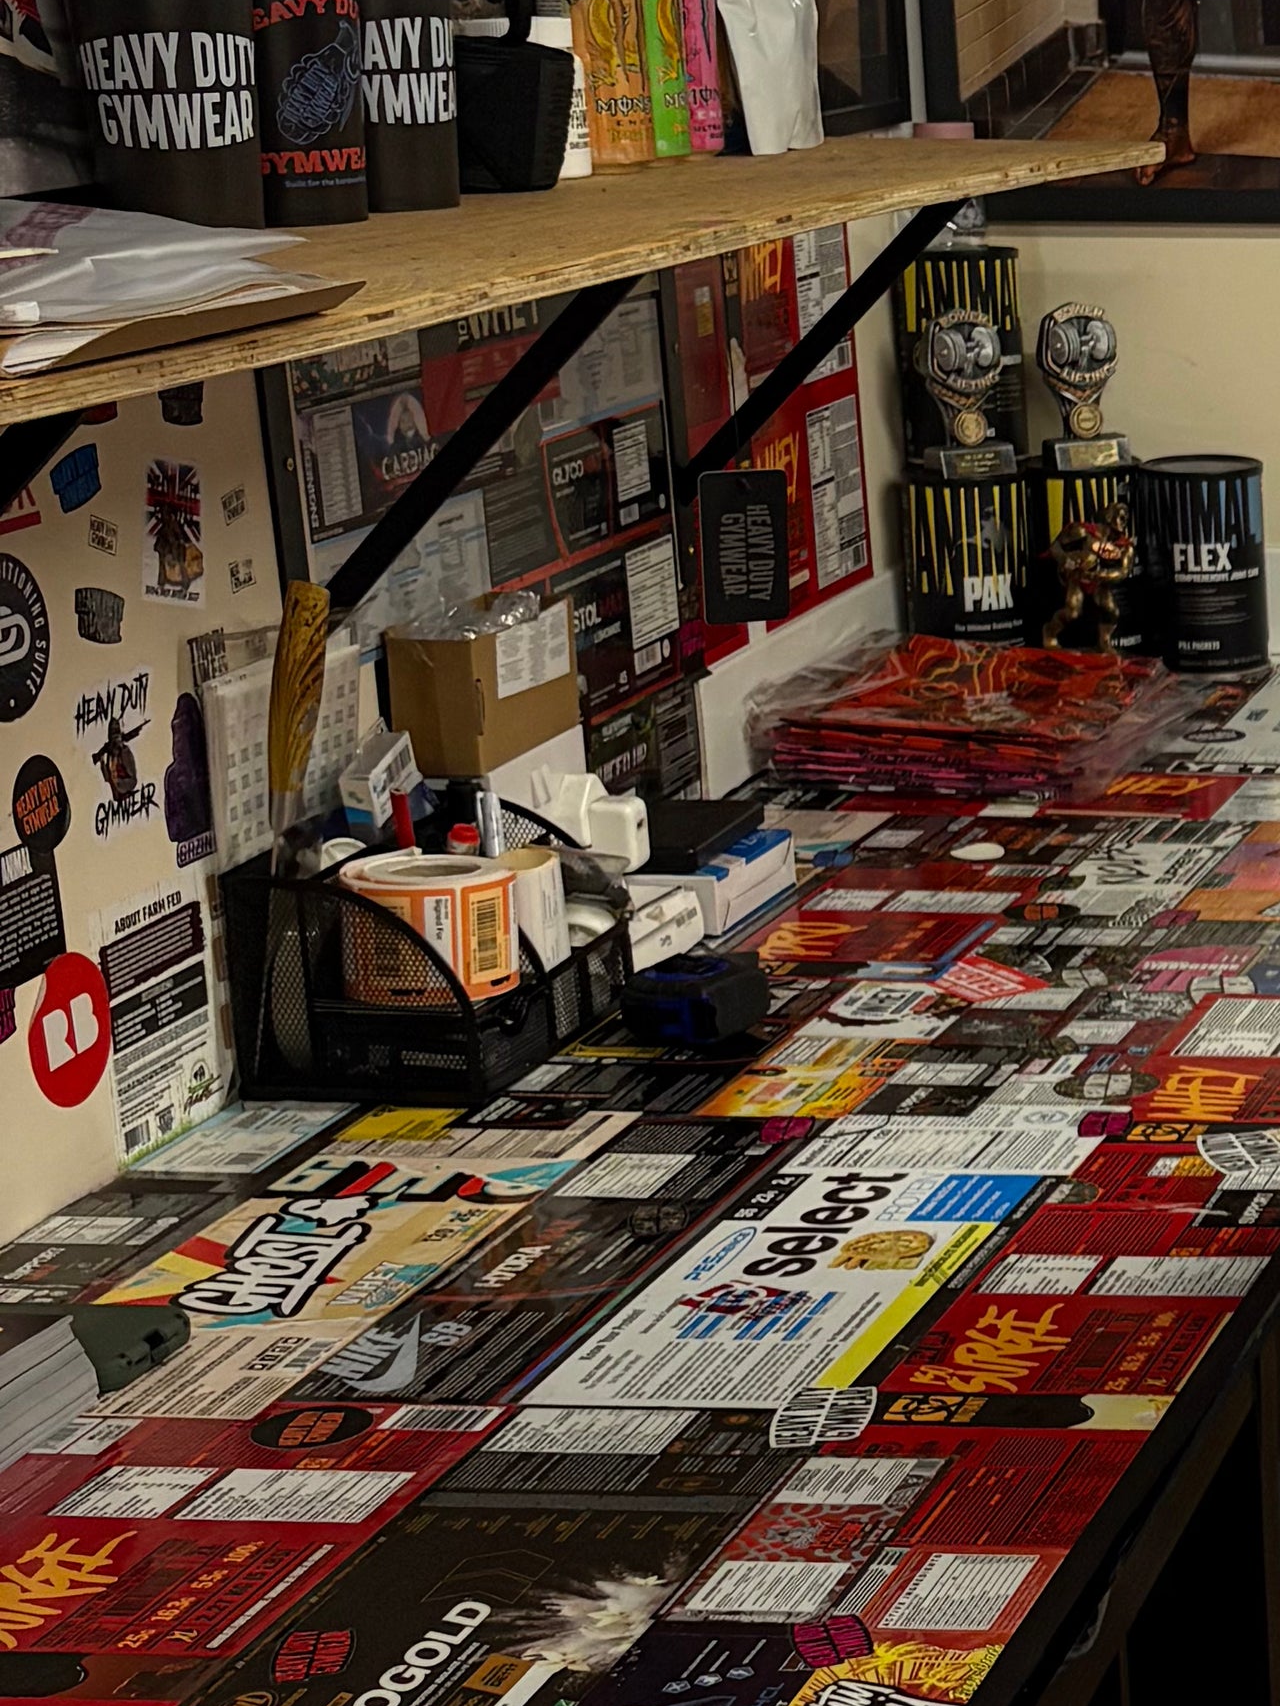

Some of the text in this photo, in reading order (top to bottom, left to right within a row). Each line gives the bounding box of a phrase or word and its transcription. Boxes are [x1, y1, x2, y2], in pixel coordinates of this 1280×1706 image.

[80, 31, 179, 91] HEAVY
[191, 32, 257, 88] DUTY
[98, 91, 255, 150] GYMWEAR
[940, 309, 990, 329] POWER
[1052, 302, 1104, 321] POWER
[947, 372, 1000, 392] LIFTING
[1060, 364, 1118, 385] LIFTING
[719, 512, 748, 598] GYMWEAR
[747, 504, 774, 601] HEAVY DUTY
[1172, 542, 1233, 572] FLEX
[962, 572, 1014, 613] PAK
[26, 638, 49, 697] SUITE
[74, 672, 150, 740] HEAVY DUTY
[94, 782, 161, 840] GYMWEAR
[114, 890, 182, 935] ABOUT FARM FED
[40, 990, 101, 1073] RB
[742, 1172, 909, 1278] select
[177, 1215, 363, 1316] GHOST
[420, 1320, 473, 1346] SB
[945, 1302, 1072, 1393] SURGE
